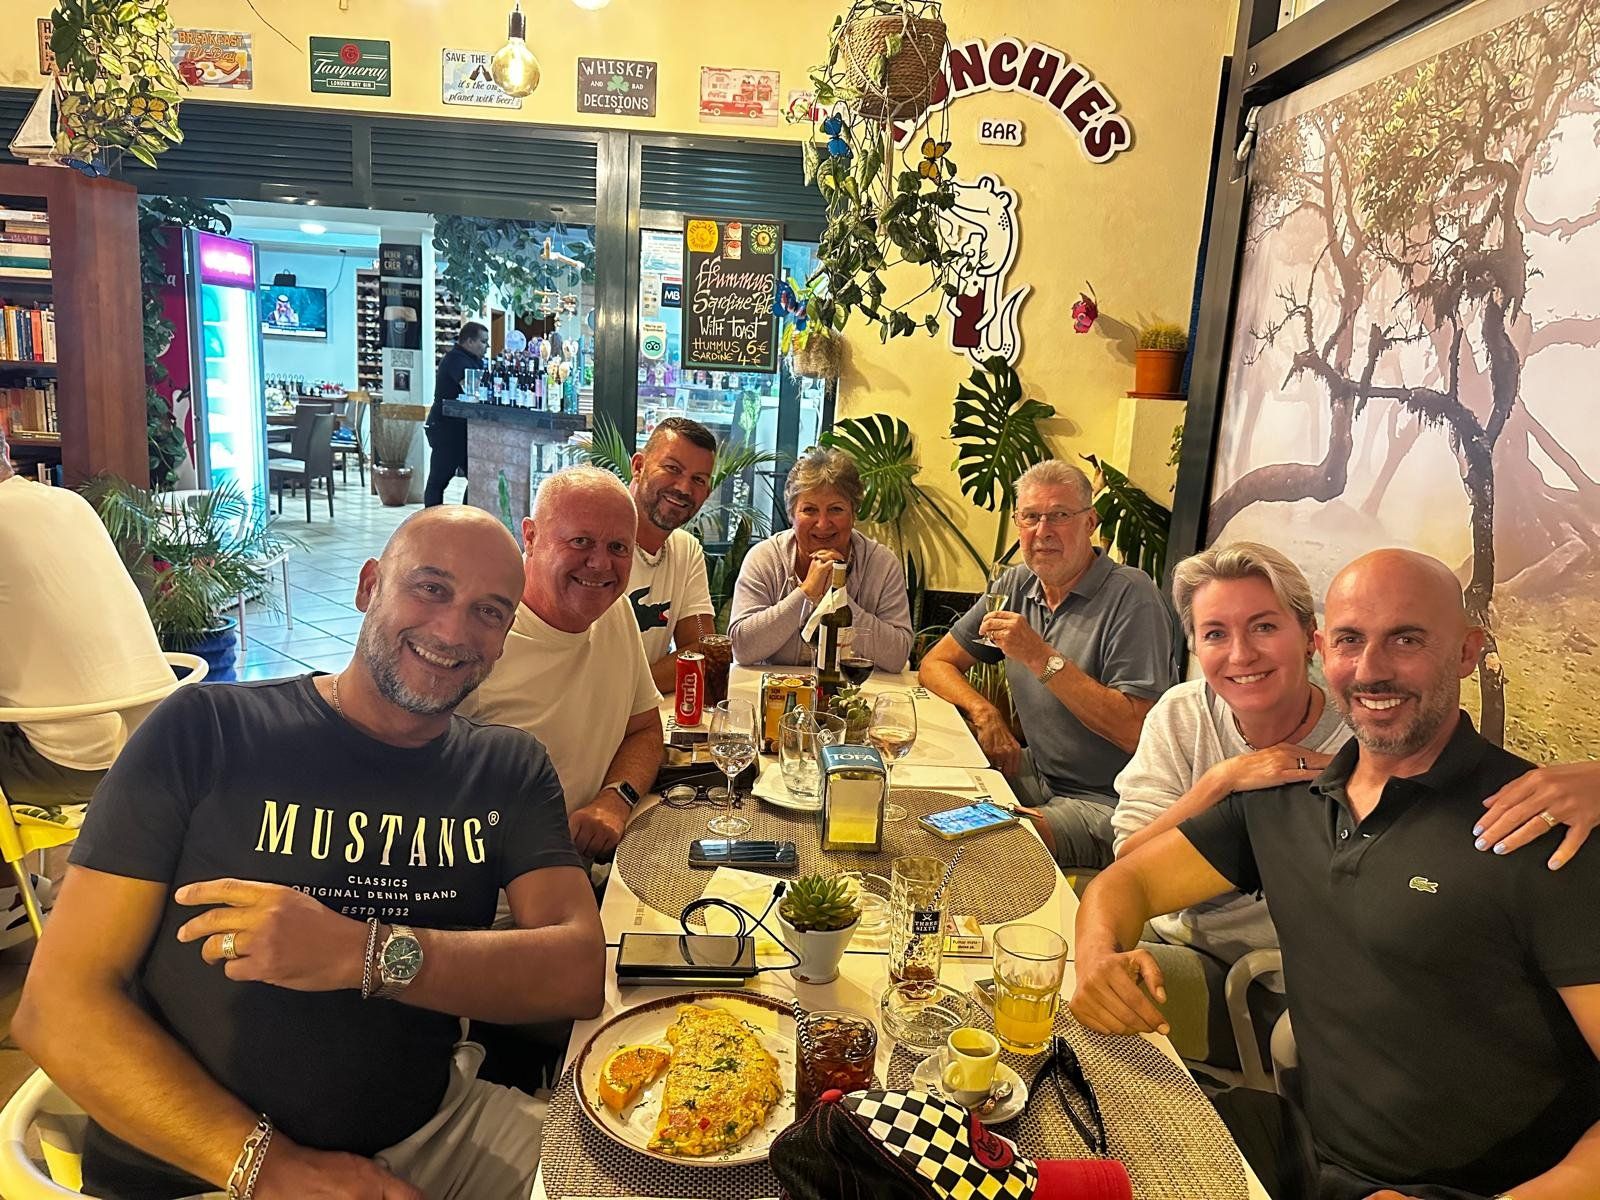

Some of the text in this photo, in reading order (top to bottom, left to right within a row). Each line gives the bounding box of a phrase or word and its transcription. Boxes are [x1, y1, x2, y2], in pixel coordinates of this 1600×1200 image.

[178, 31, 243, 47] BREAKFAST
[445, 52, 466, 62] SAVE
[471, 54, 486, 64] THE
[313, 58, 388, 81] Tanqueray
[581, 61, 653, 80] WHISKEY
[472, 81, 485, 90] the
[448, 92, 473, 103] planet
[475, 95, 494, 103] with
[584, 93, 649, 110] DECISIONS
[981, 122, 1017, 140] BAR
[695, 256, 775, 293] Hummus
[693, 290, 752, 315] Sardine
[692, 337, 740, 353] HUMMUS
[347, 875, 408, 888] CLASSICS
[367, 891, 409, 901] DENIM
[414, 889, 457, 901] BRAND
[341, 906, 409, 917] ESTD 1932
